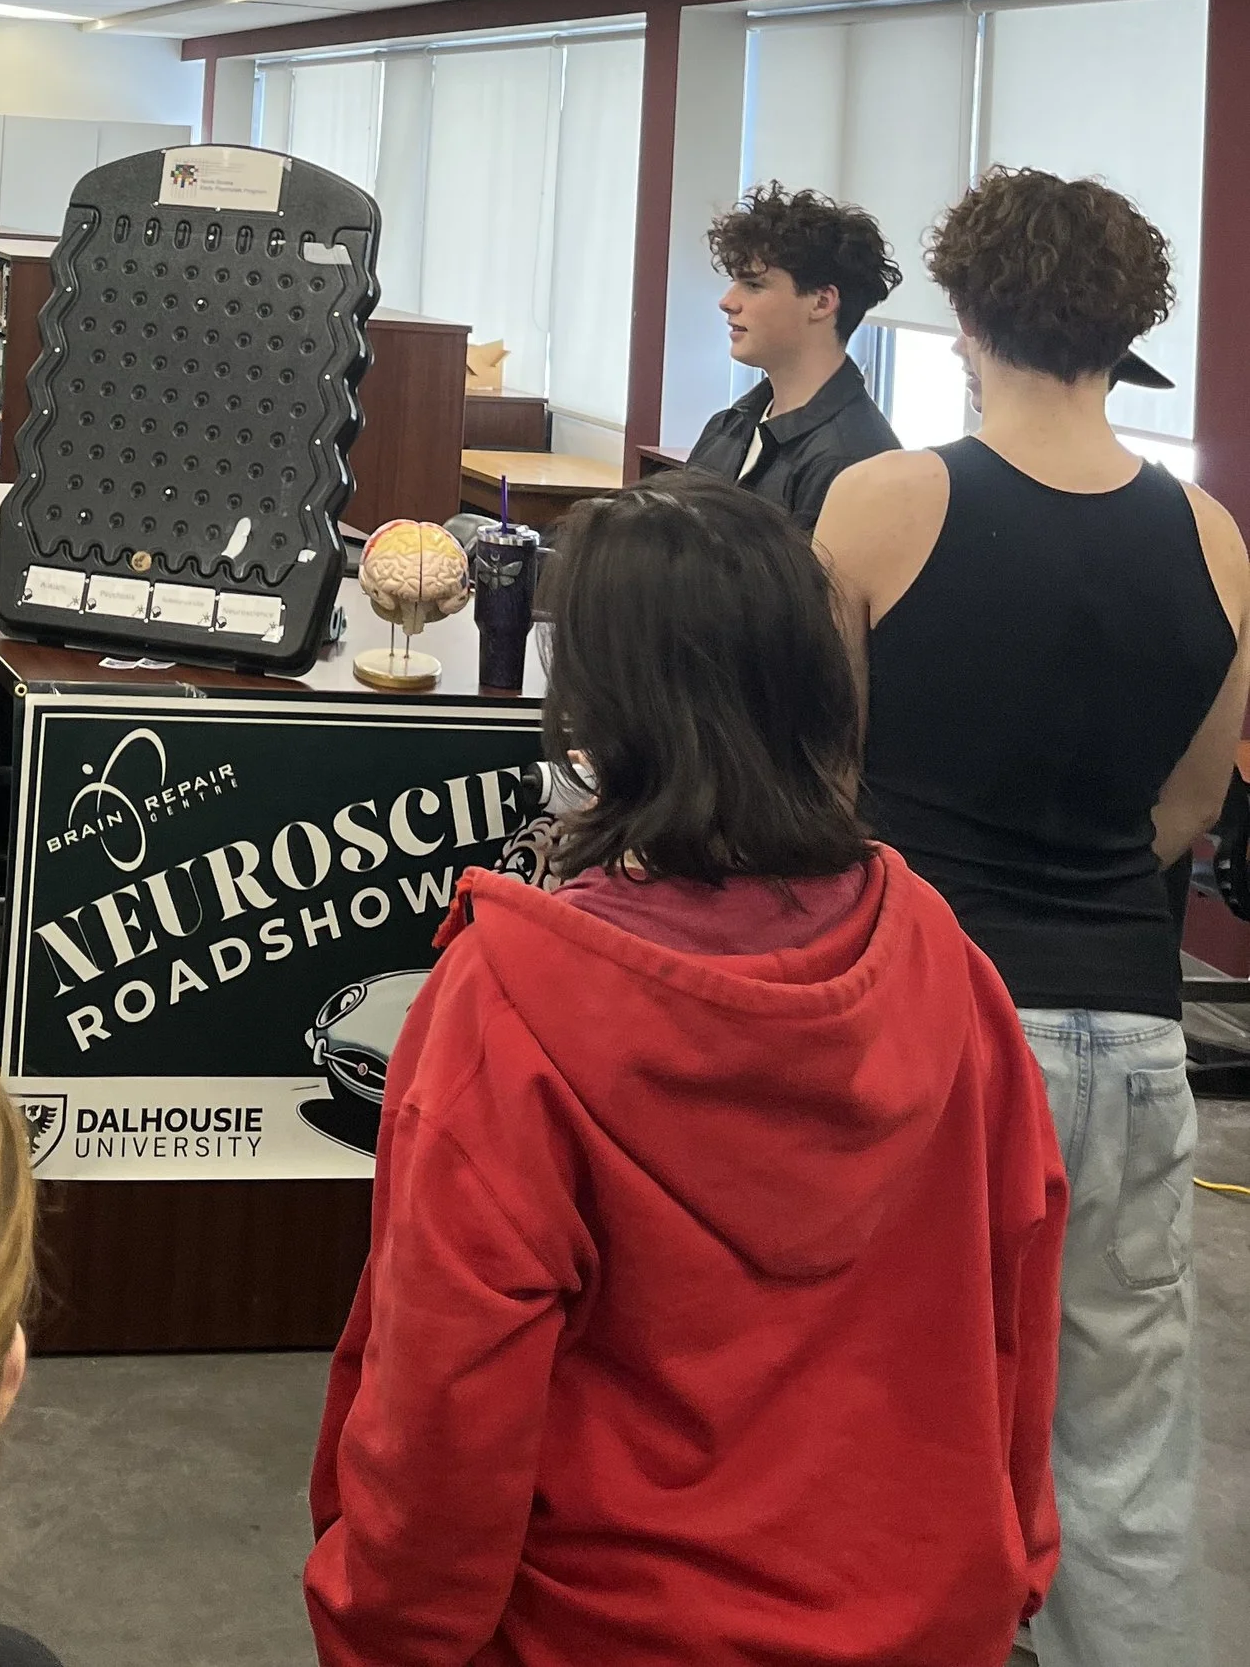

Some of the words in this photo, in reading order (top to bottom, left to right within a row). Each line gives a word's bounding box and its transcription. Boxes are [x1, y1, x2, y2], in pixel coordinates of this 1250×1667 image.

[46, 810, 123, 853] BRAIN
[144, 763, 234, 811] REPAIR
[150, 778, 238, 823] CENTRE
[33, 766, 527, 999] NEUROSCIE
[66, 866, 453, 1052] ROADSHOW
[75, 1136, 262, 1158] UNIVERSITY
[77, 1107, 263, 1134] DALHOUSIE
